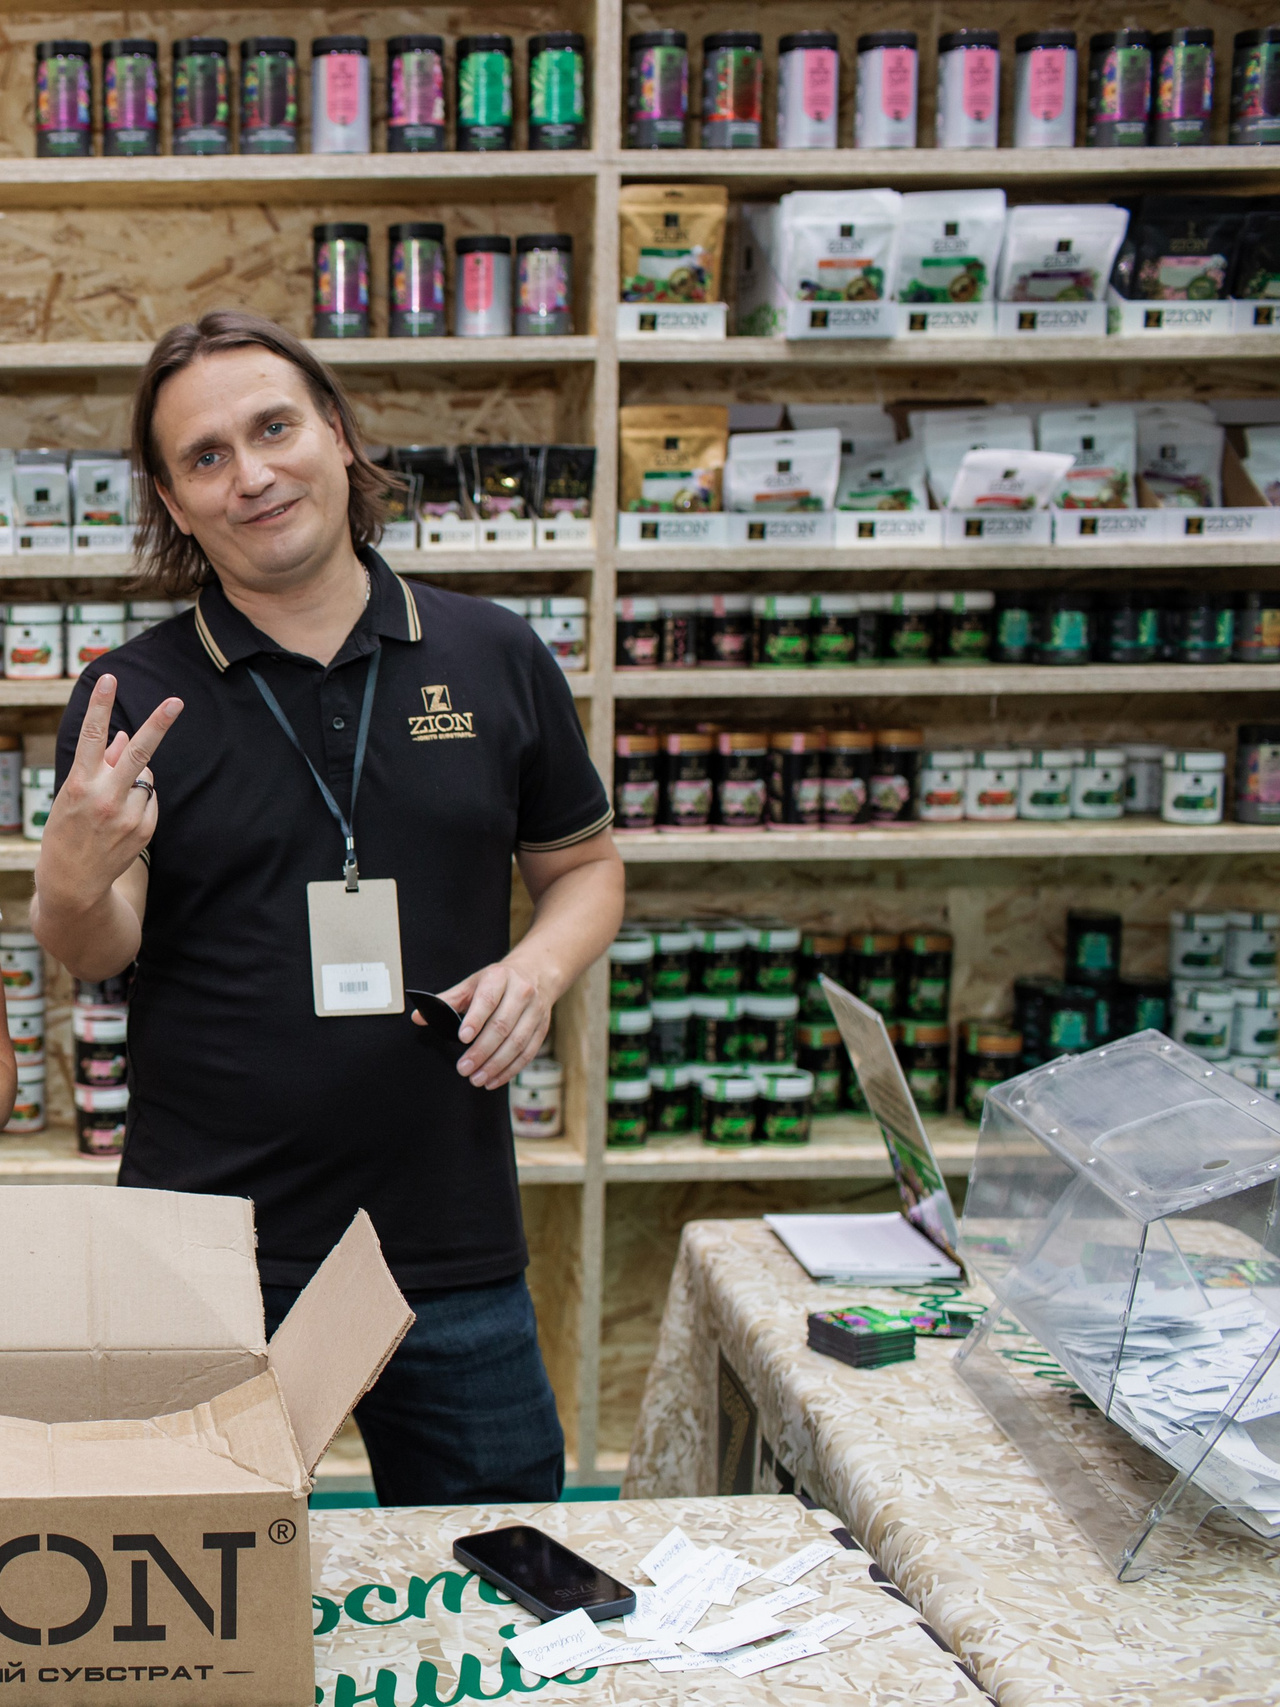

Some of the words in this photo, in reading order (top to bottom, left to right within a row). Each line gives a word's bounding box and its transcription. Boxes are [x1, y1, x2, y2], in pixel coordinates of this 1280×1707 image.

[1163, 309, 1213, 323] ZION
[408, 712, 473, 735] ZION
[38, 1664, 215, 1684] СУБСТРАТ
